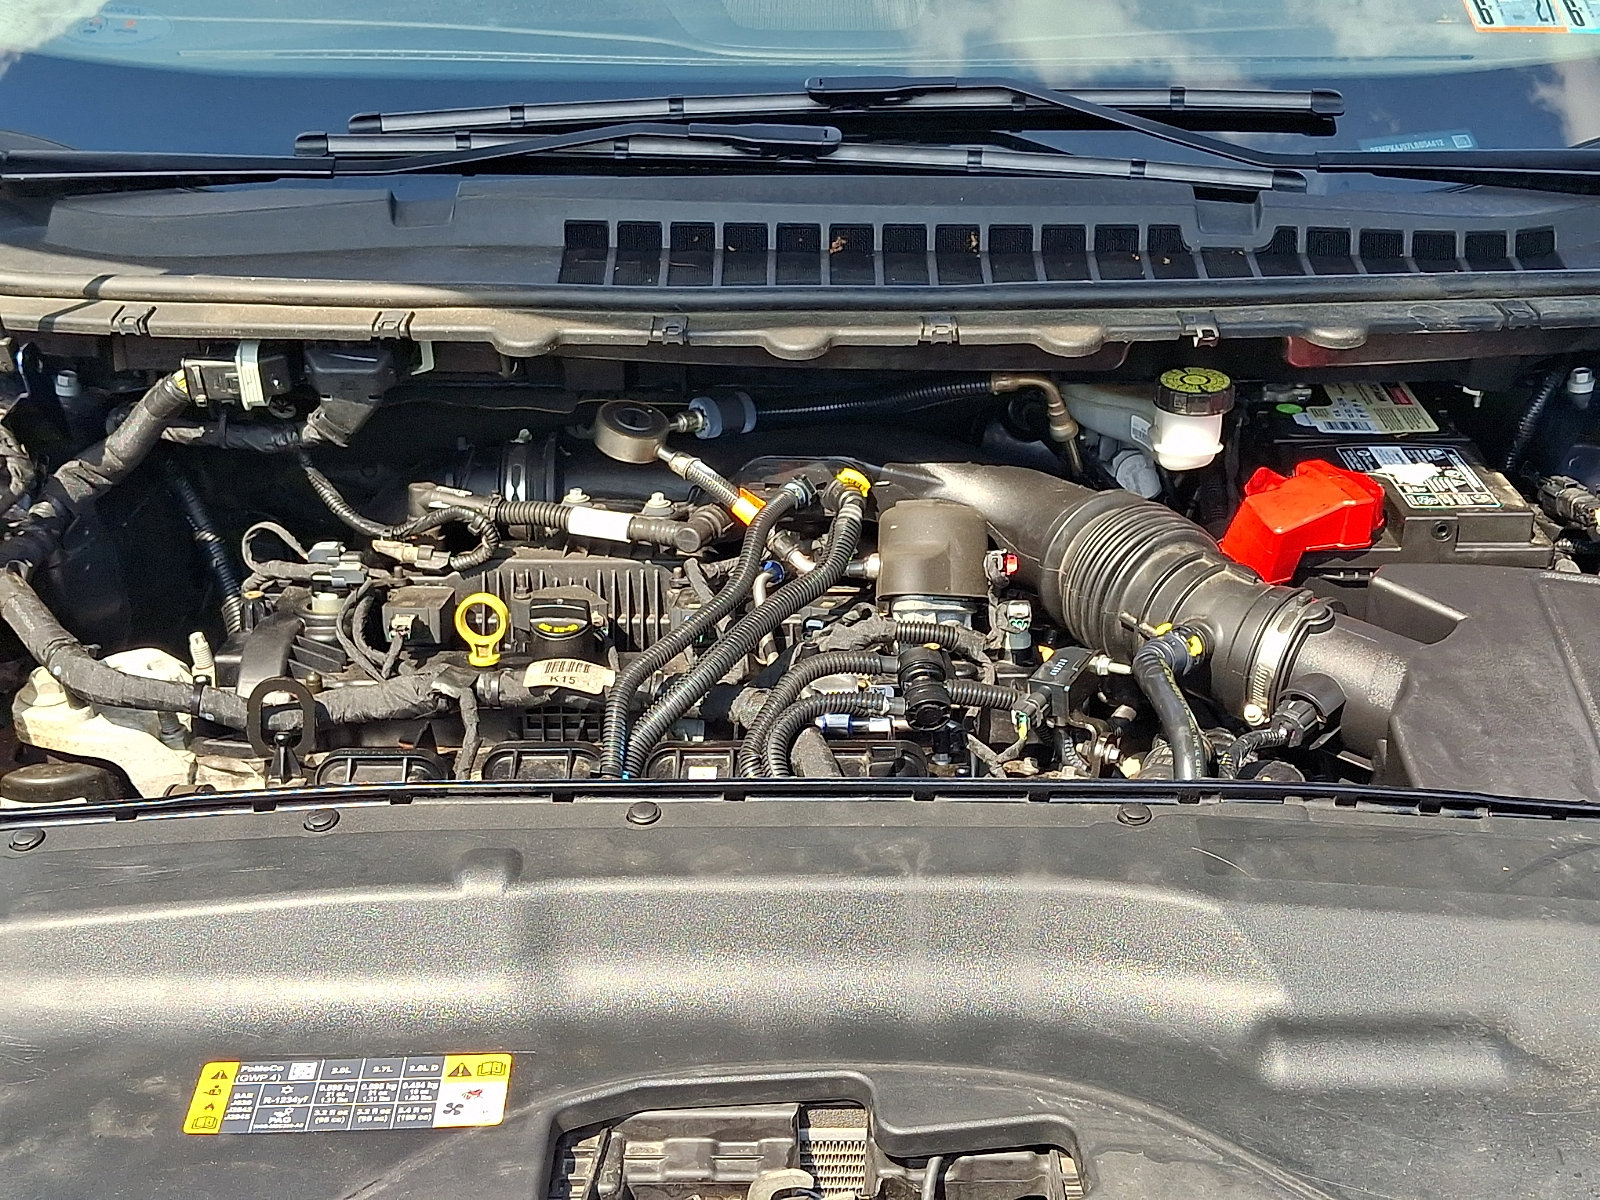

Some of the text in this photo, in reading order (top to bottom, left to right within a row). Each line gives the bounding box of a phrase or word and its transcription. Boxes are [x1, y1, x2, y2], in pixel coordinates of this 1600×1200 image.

[549, 675, 577, 685] K15
[240, 1064, 285, 1073] FoMoCo
[372, 1065, 393, 1073] 2.7L
[236, 1073, 282, 1082] (GWP 4)
[262, 1095, 309, 1105] R-1234yf
